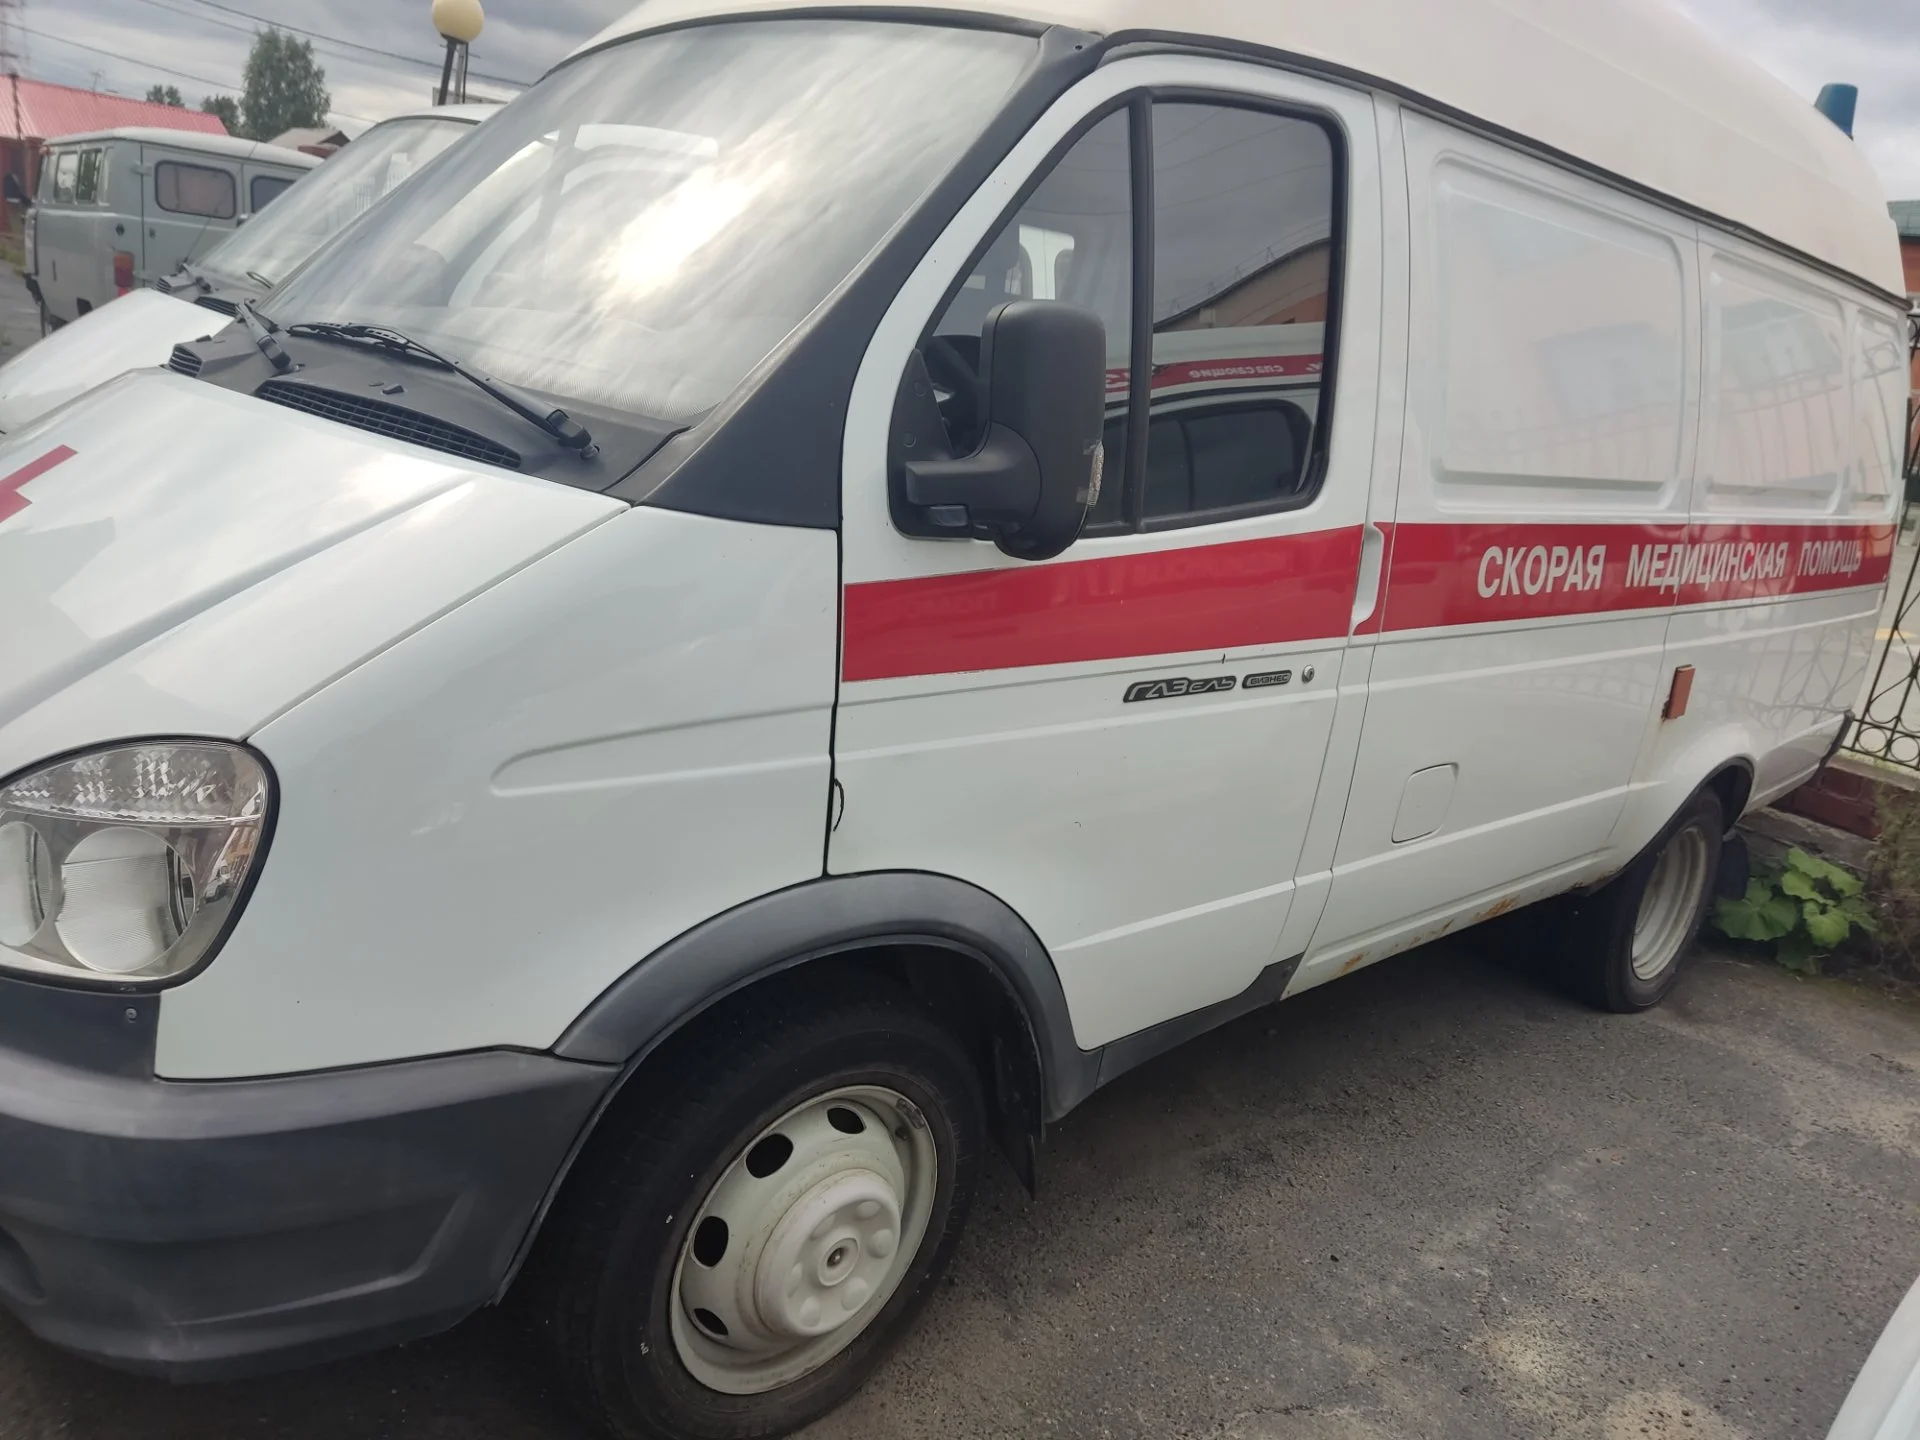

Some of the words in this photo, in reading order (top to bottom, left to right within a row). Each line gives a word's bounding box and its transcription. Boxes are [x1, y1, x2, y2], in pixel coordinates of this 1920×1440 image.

[1477, 544, 1606, 598] СКОРАЯ
[1624, 541, 1790, 595] МЕДИЦИНСКАЯ
[1796, 540, 1863, 579] ПОМОЩЬ
[1249, 673, 1290, 687] БИЗНЕС
